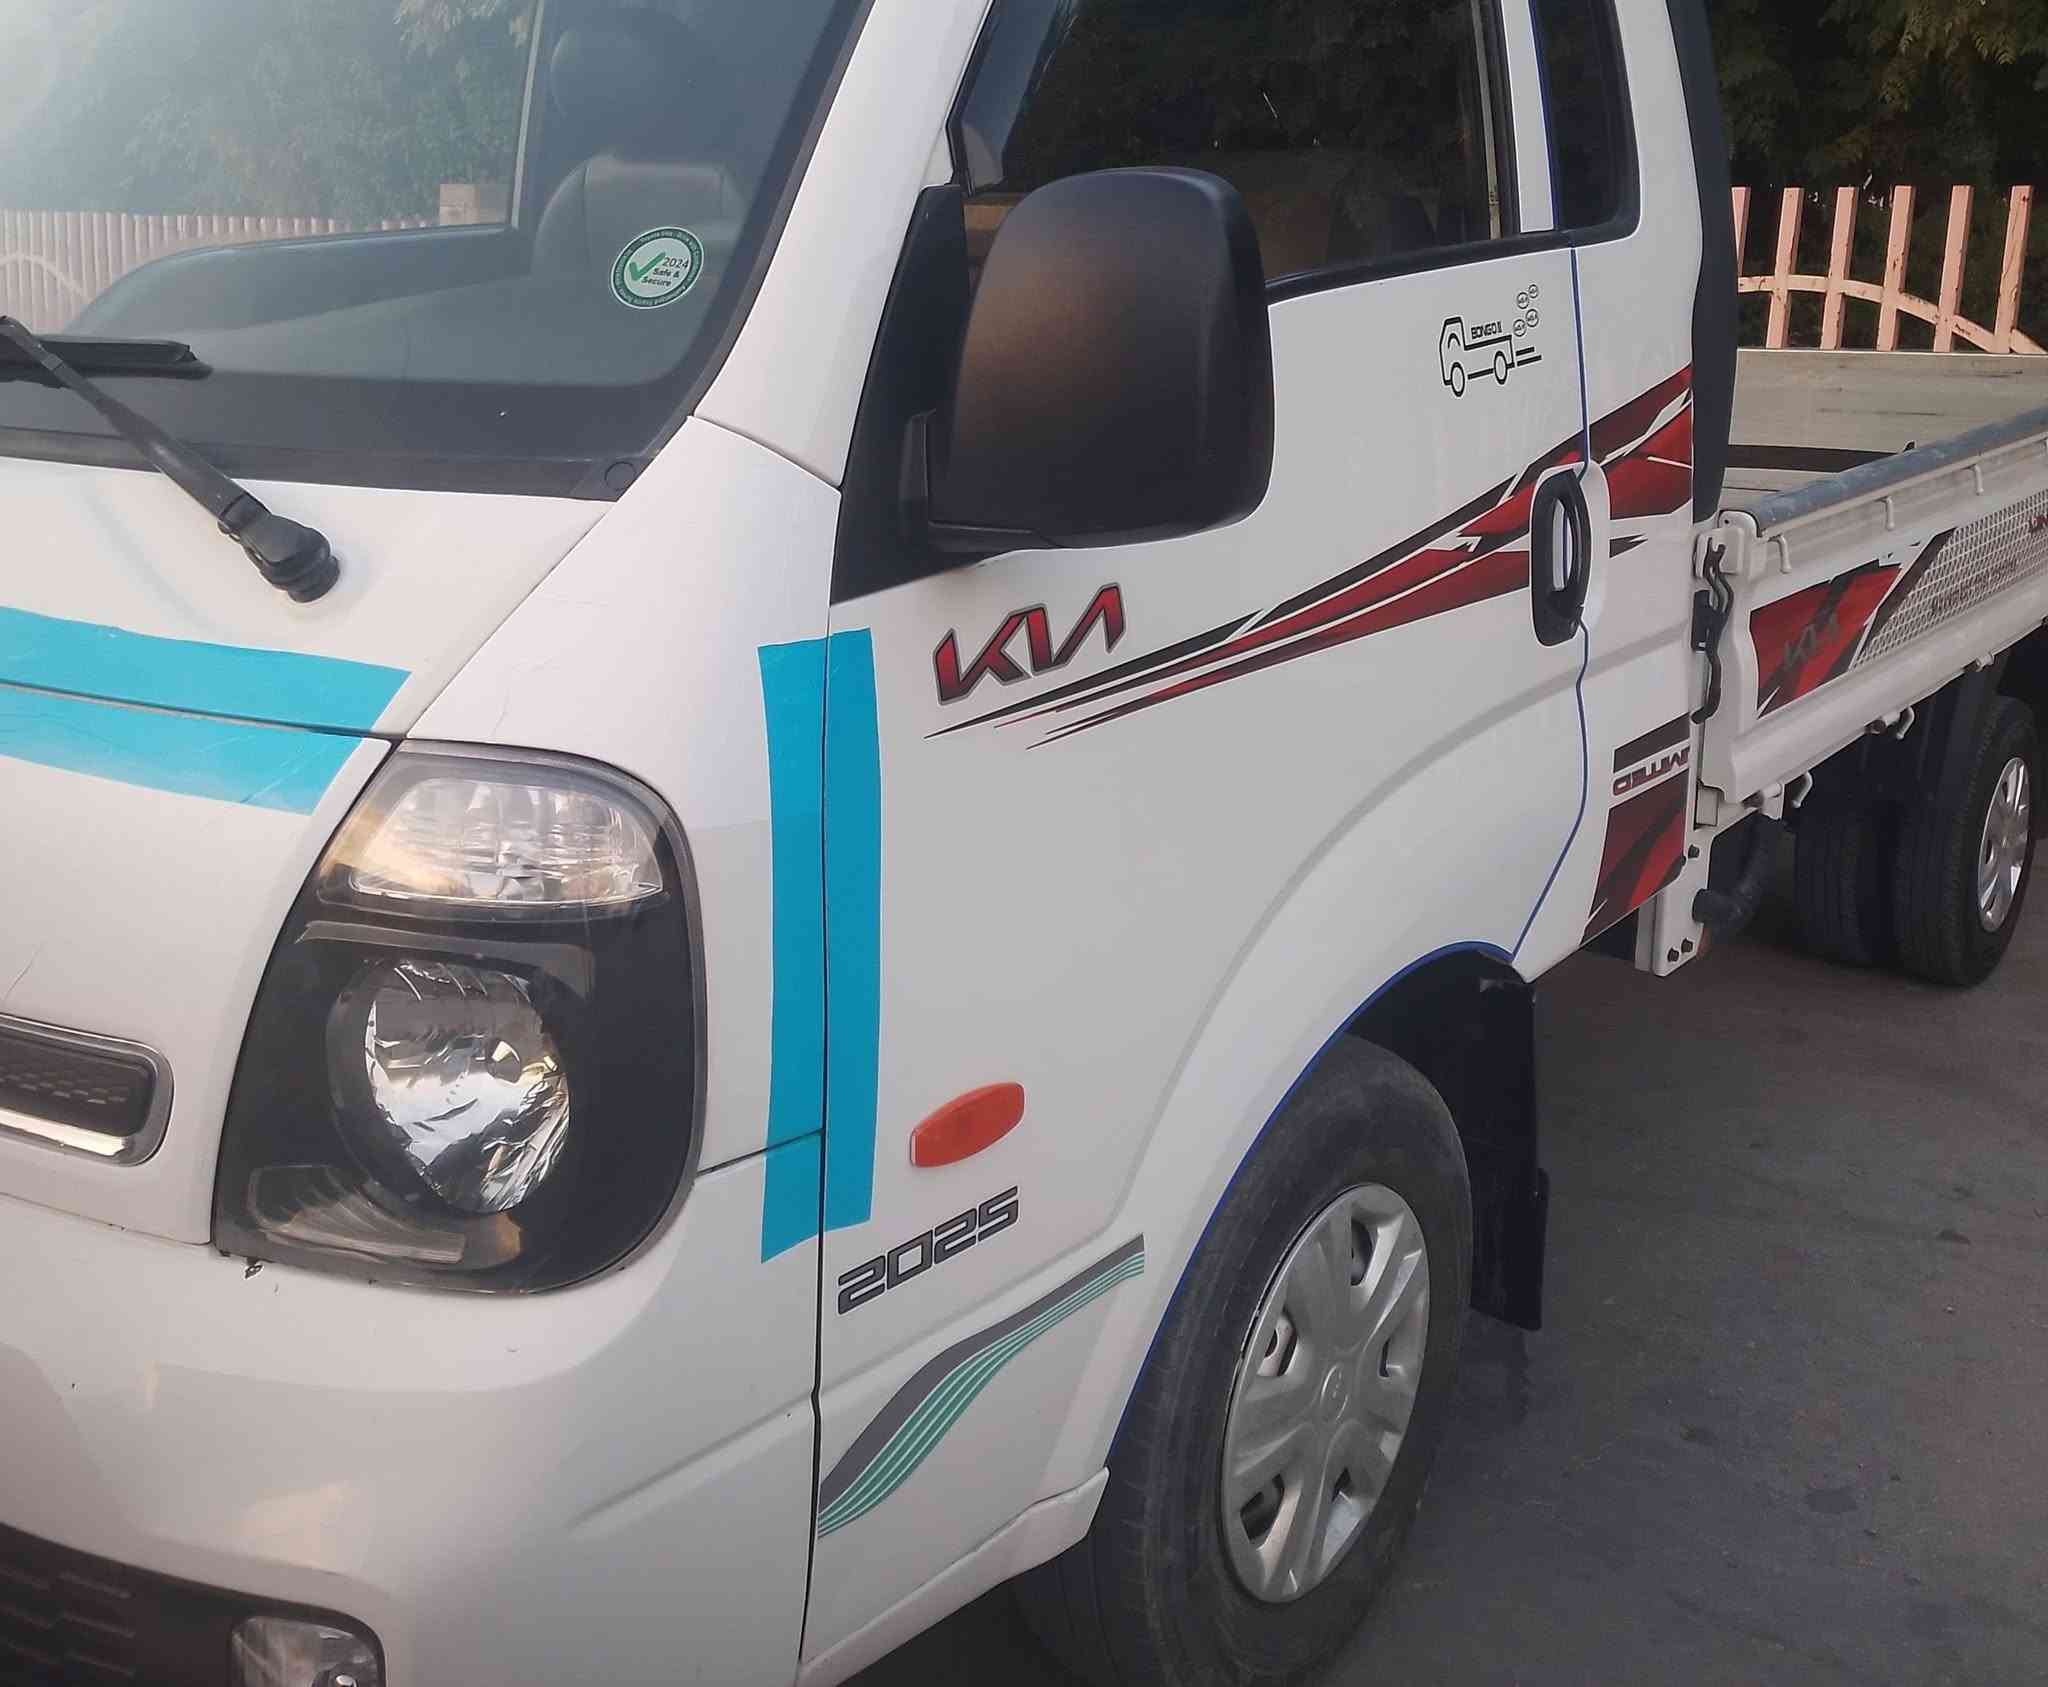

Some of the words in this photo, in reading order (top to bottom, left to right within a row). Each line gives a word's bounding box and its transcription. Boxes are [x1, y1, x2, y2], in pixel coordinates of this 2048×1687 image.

[662, 257, 689, 269] 2024
[653, 268, 672, 277] Safe
[673, 270, 680, 278] &
[641, 276, 672, 286] Secure
[1471, 322, 1497, 339] BONGO
[933, 581, 1126, 706] KIA
[838, 1185, 1019, 1316] 2025
